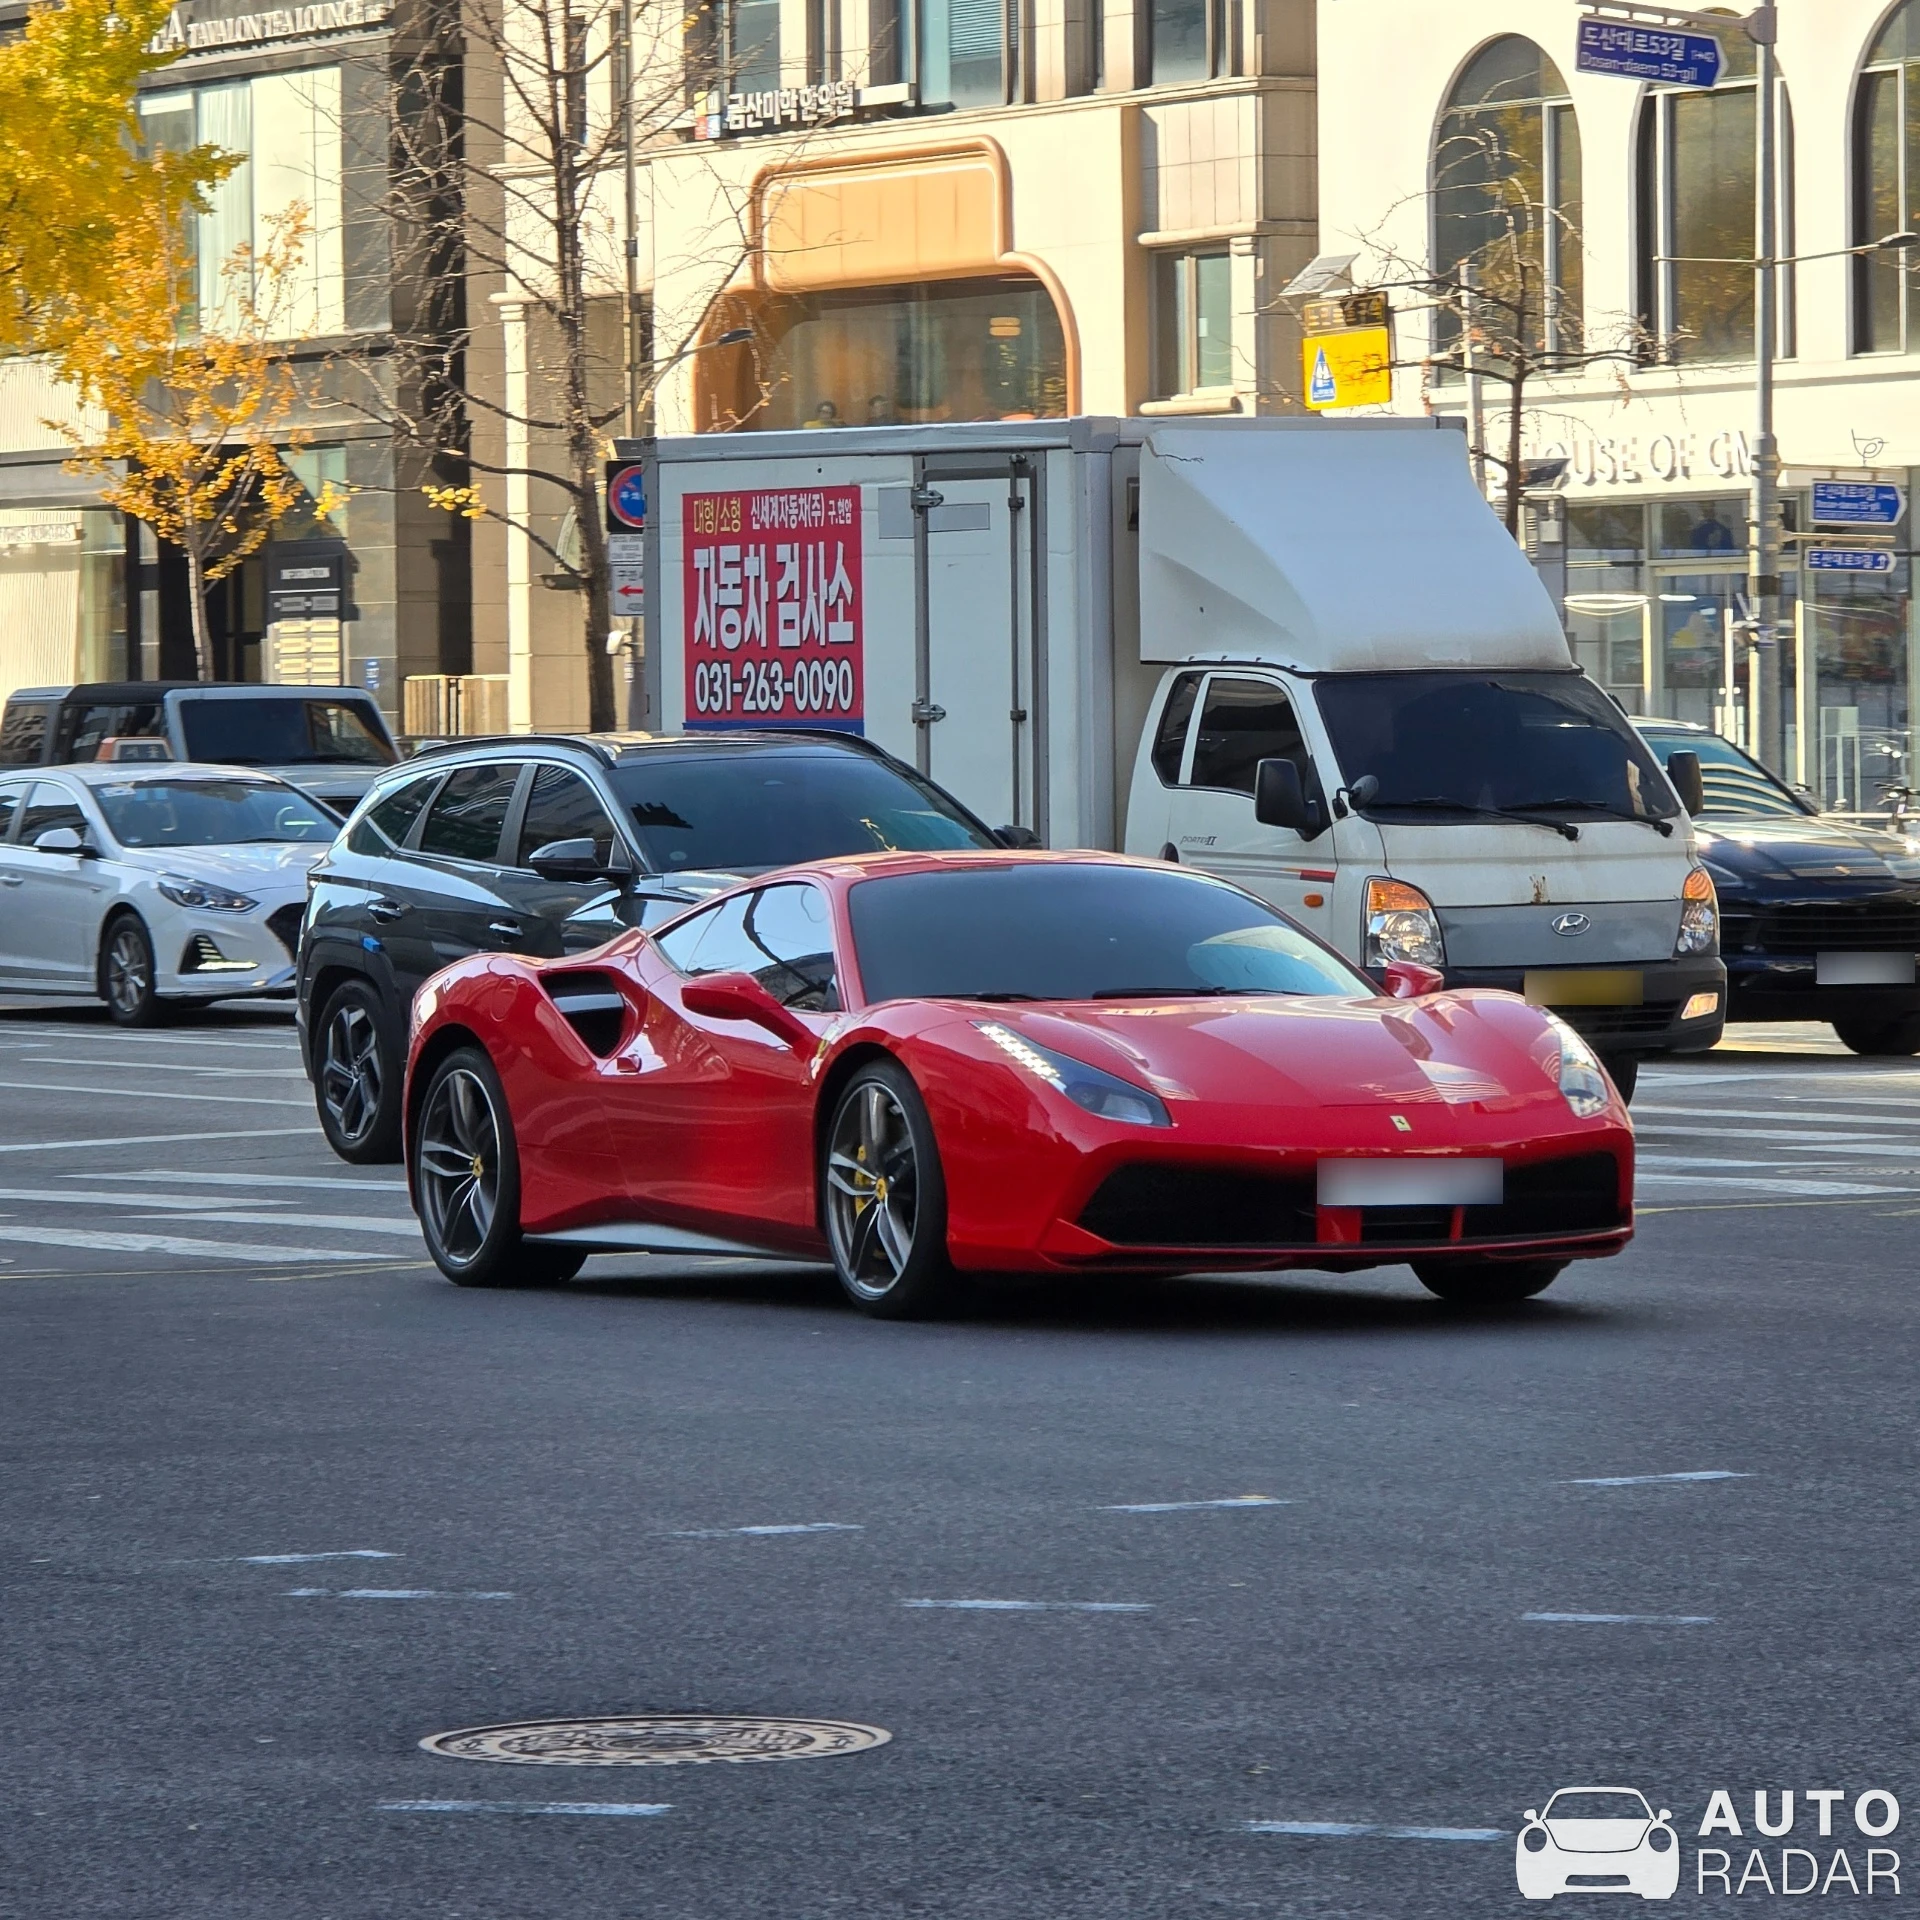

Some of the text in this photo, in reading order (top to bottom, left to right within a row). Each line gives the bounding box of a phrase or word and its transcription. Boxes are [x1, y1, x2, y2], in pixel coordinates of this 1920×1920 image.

[1580, 51, 1698, 82] Dosan-daero 53-gil
[1581, 26, 1686, 61] 도산대로53길
[1648, 432, 1698, 482] OF
[693, 497, 742, 535] 대형/소형
[751, 492, 825, 530] 신세계자동차(주)
[693, 540, 854, 649] 자동차 검사소
[694, 659, 854, 713] 031-263-0090
